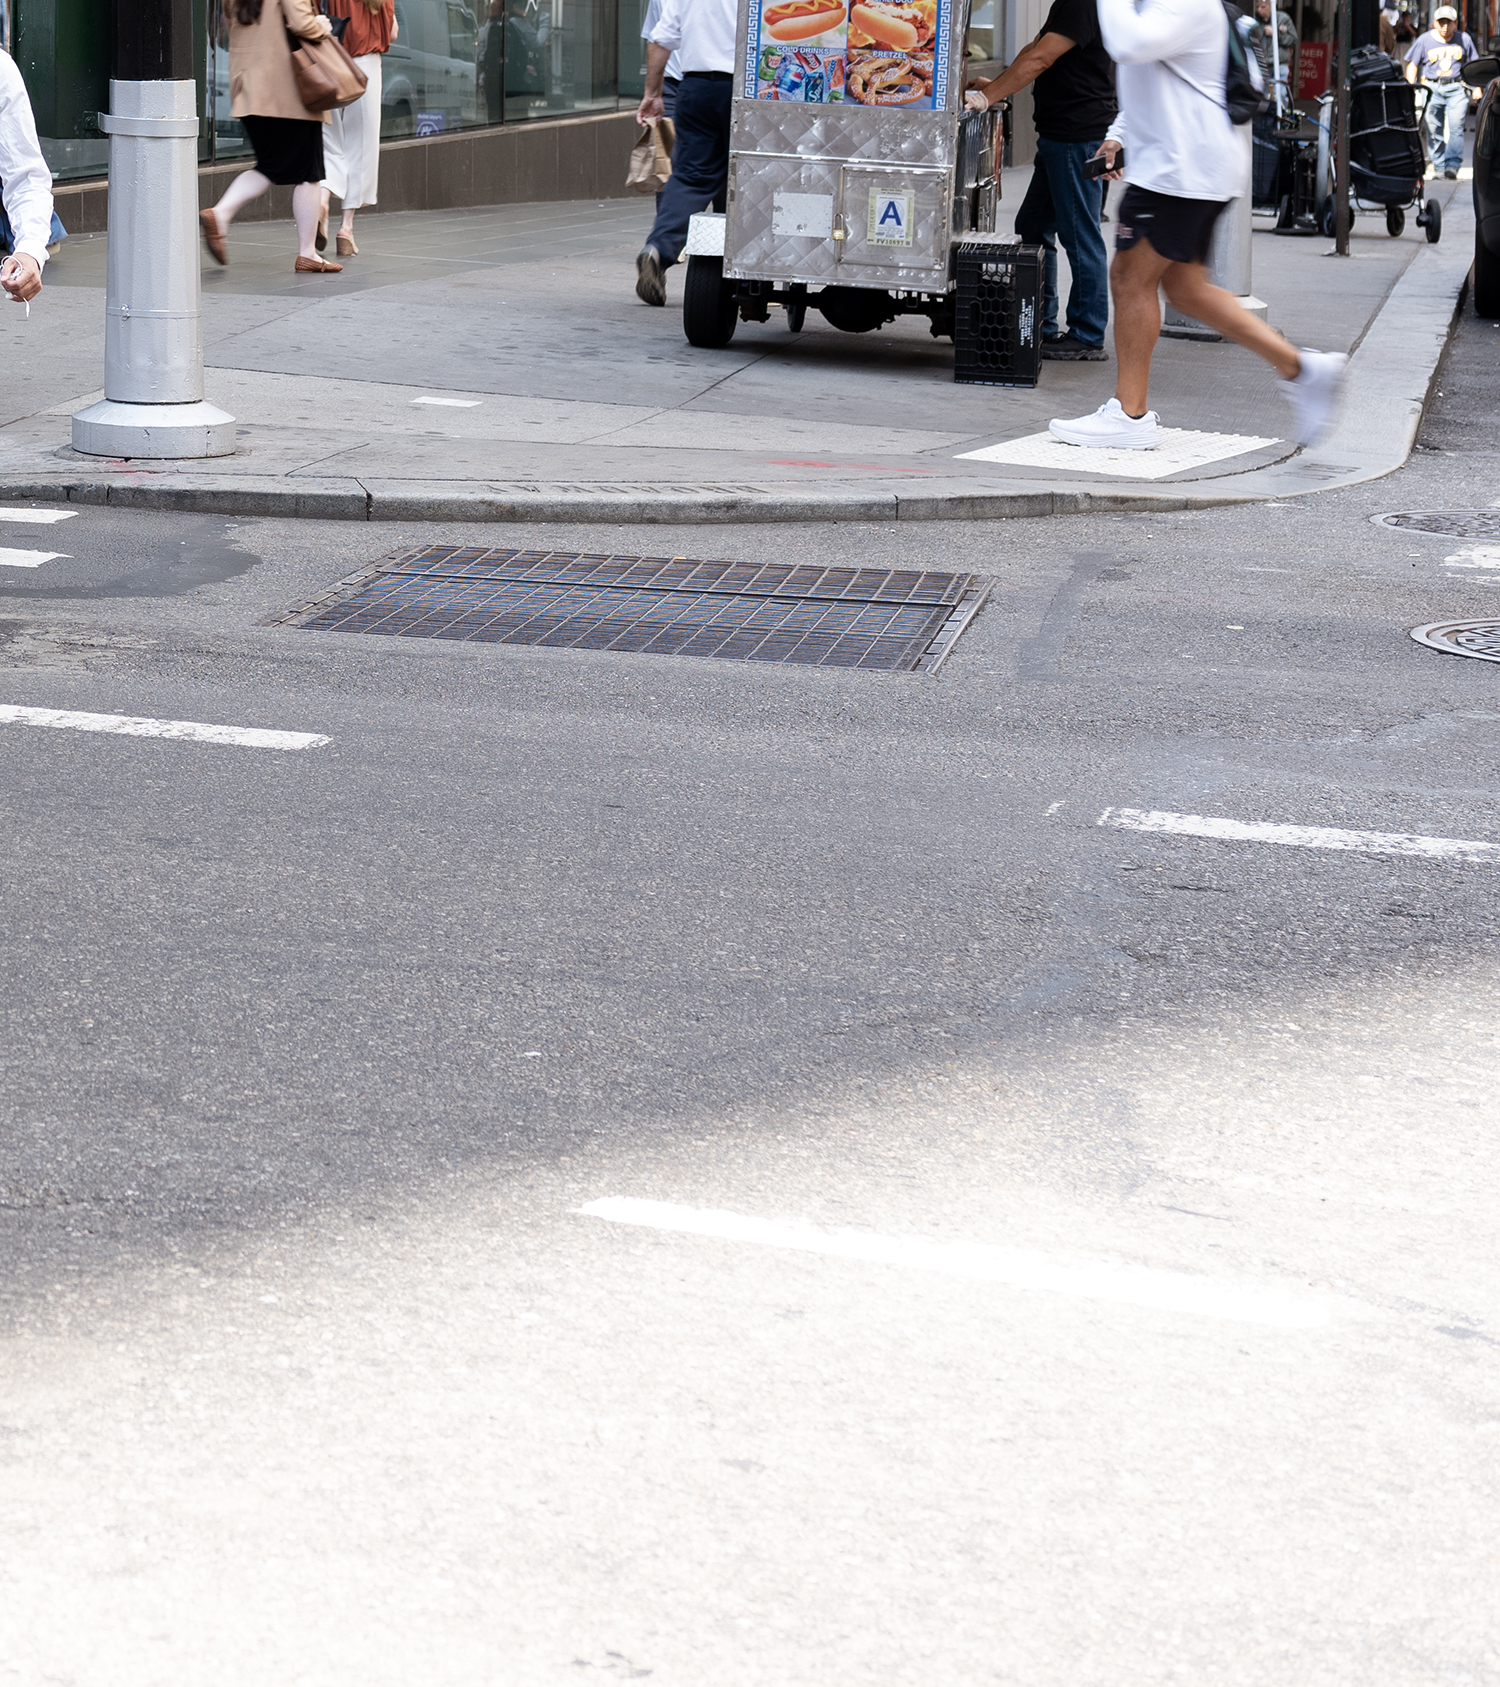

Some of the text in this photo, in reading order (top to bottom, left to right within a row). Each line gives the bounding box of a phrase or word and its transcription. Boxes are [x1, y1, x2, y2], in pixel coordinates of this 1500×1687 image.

[800, 46, 830, 55] DRINKS
[873, 51, 908, 59] PRETZEL
[878, 201, 902, 226] A
